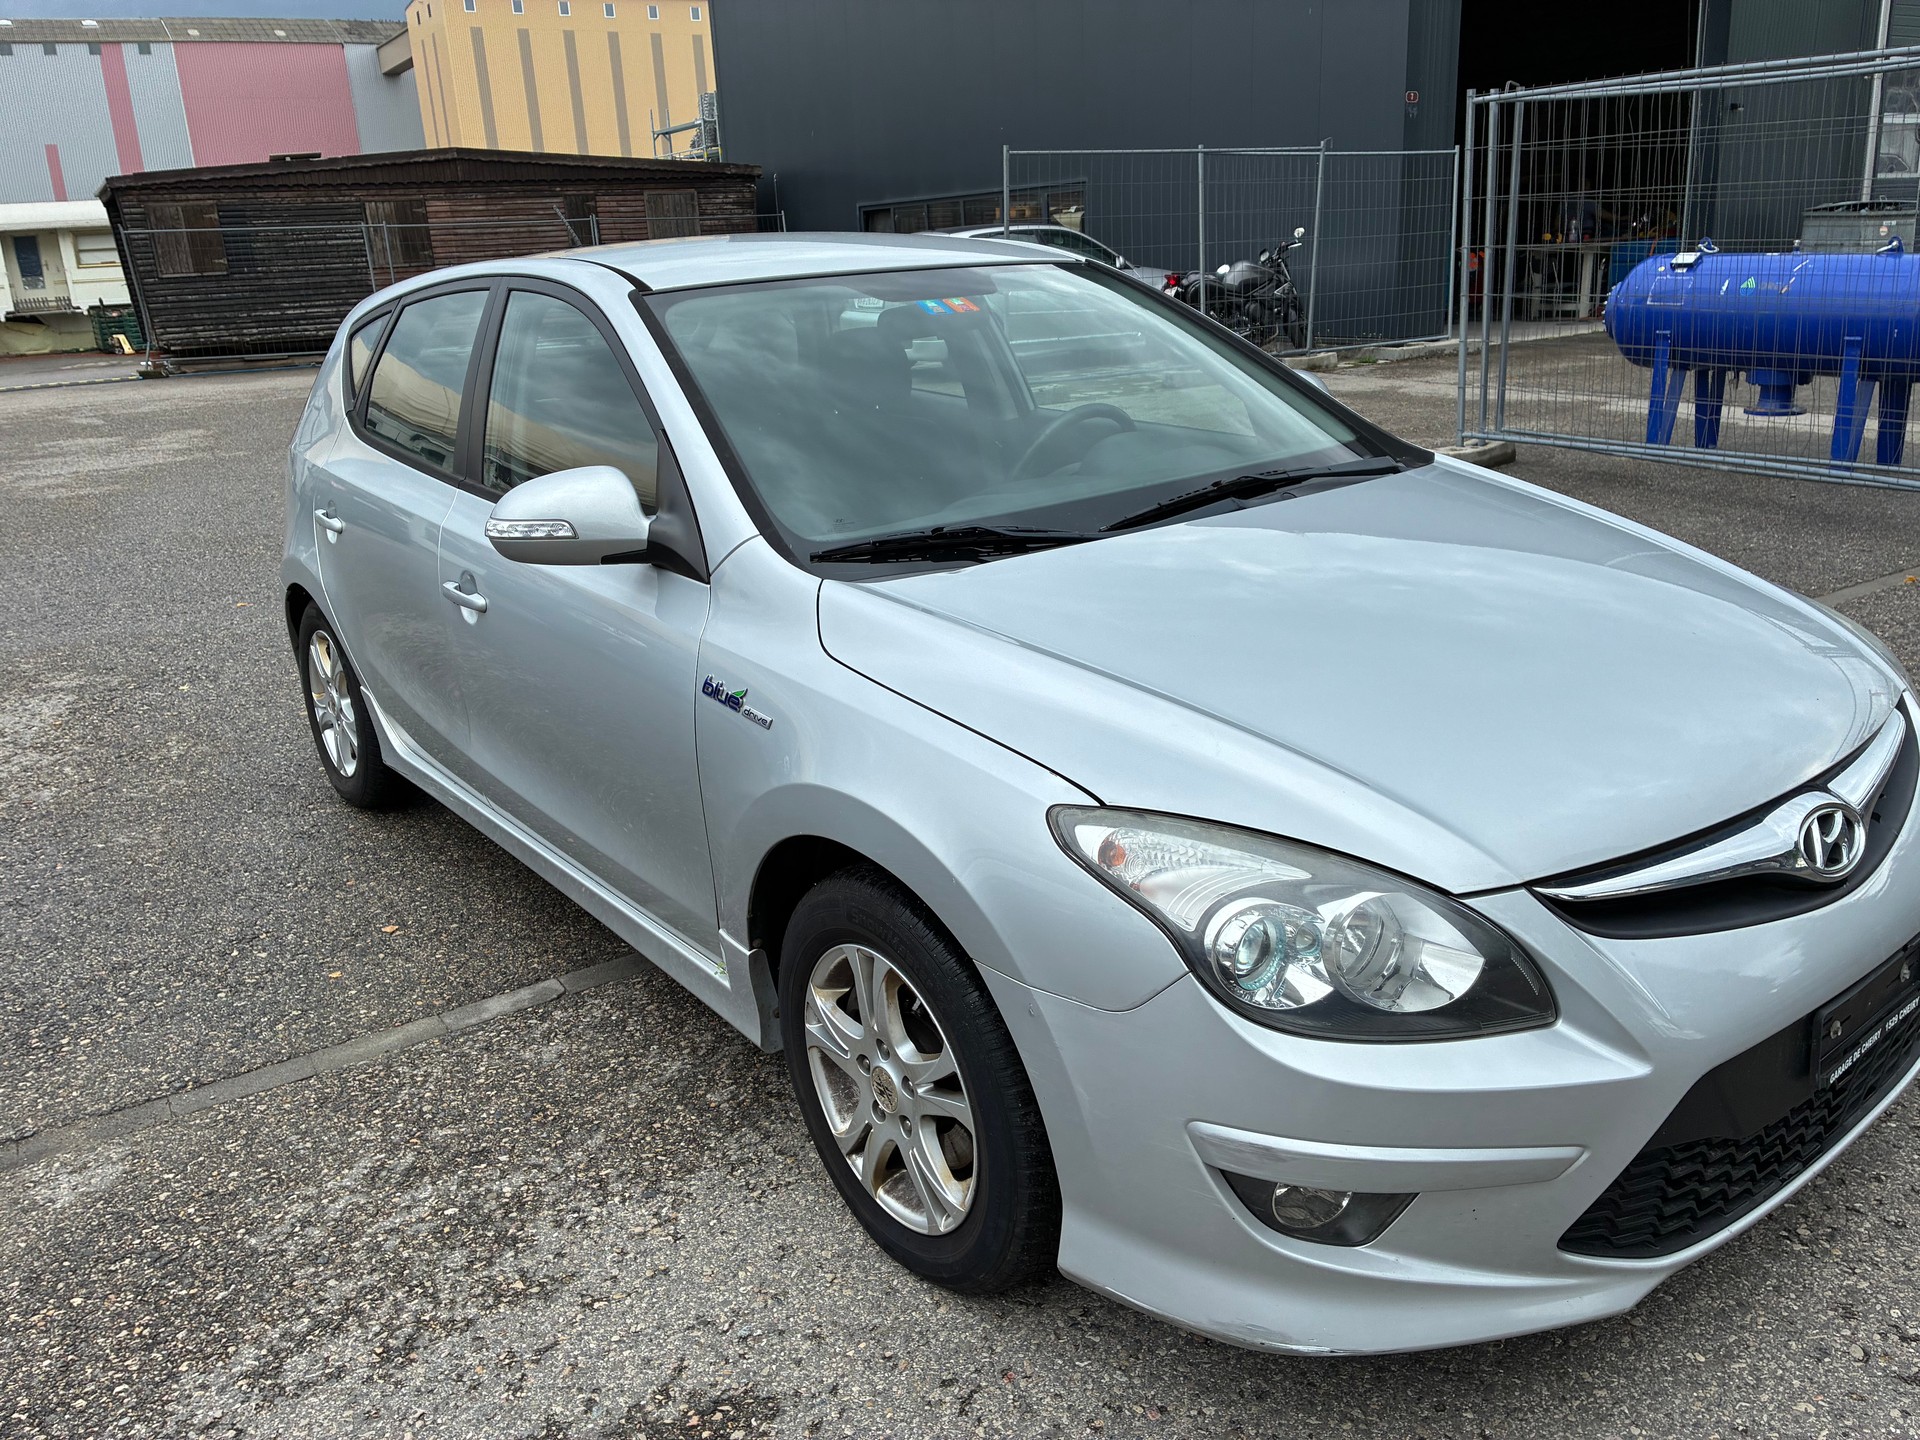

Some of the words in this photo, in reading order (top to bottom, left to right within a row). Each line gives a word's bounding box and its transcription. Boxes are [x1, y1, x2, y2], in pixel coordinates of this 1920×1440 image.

[701, 674, 743, 713] blue
[743, 708, 768, 726] drive
[1829, 1055, 1853, 1084] GARAGE
[1852, 1047, 1862, 1062] DE
[1862, 1028, 1882, 1053] CHEIRY
[1885, 1014, 1899, 1031] 1529
[1898, 996, 1920, 1020] CHEIRY
